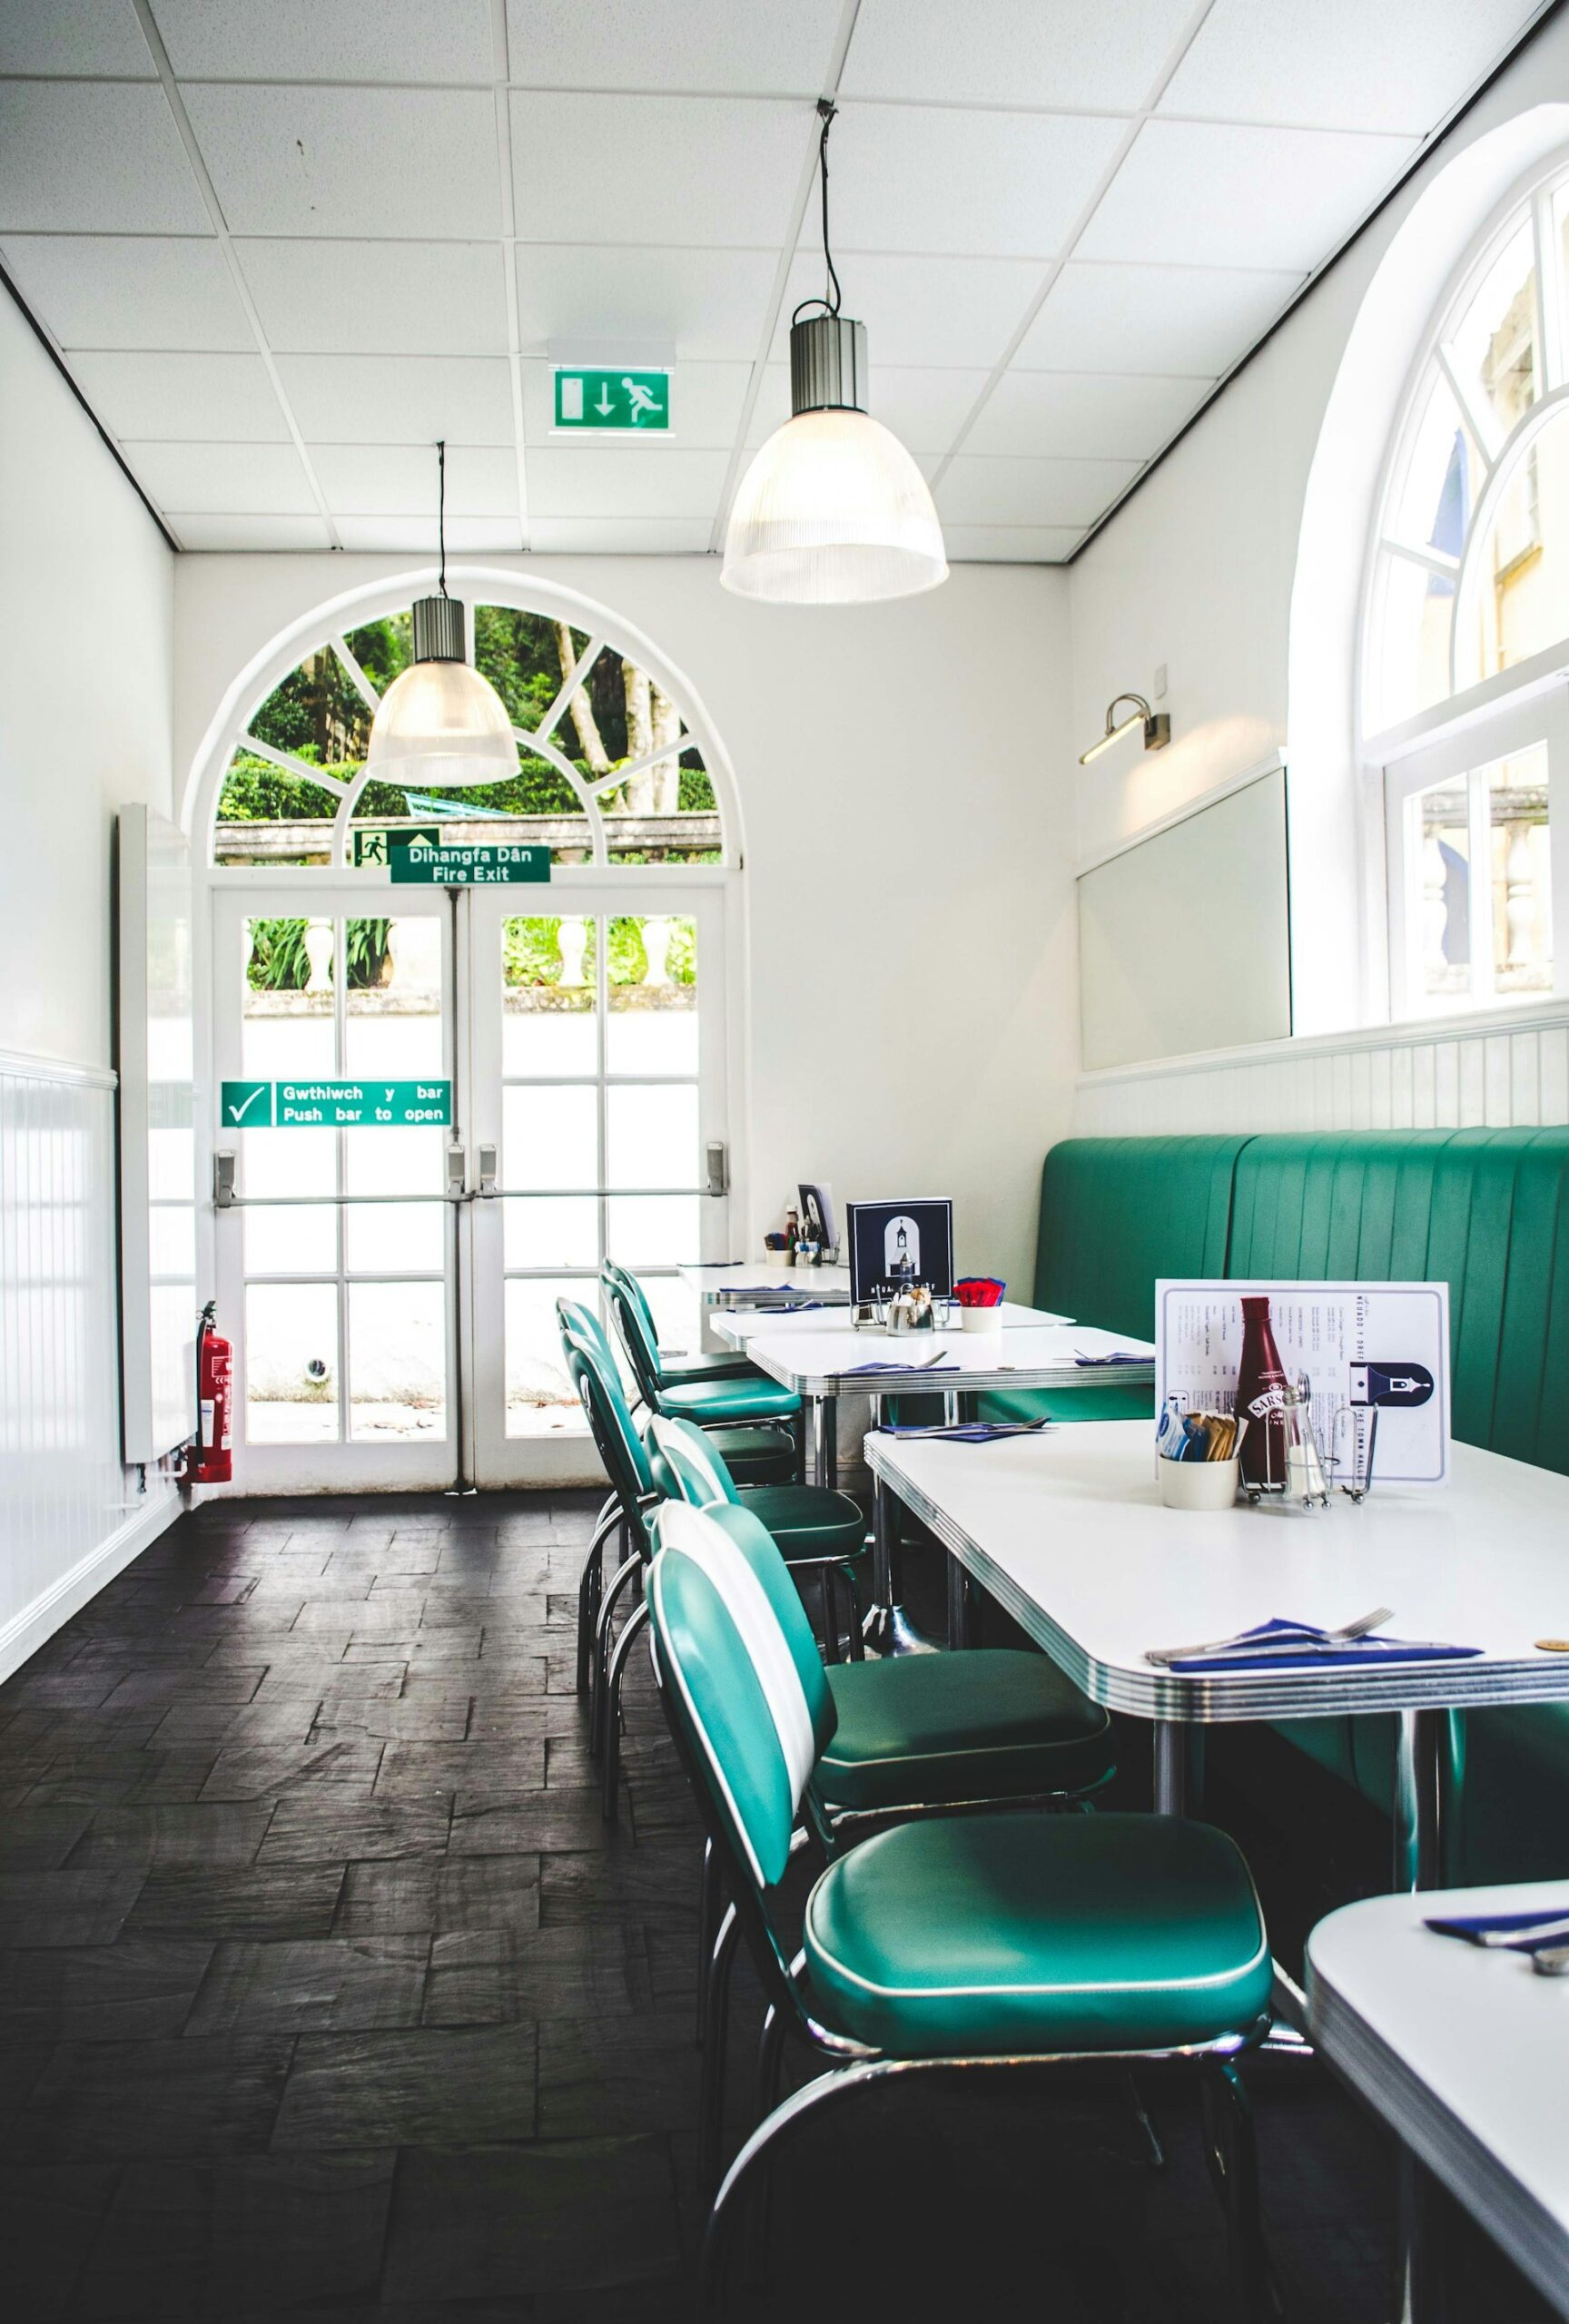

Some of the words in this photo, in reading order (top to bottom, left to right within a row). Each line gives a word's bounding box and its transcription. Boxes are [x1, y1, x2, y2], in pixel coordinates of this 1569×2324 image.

[410, 848, 490, 865] Dihangfa
[497, 847, 532, 862] Dân
[432, 866, 467, 881] Fire
[473, 866, 509, 881] Exit
[282, 1086, 363, 1100] Gwthiwch
[385, 1089, 395, 1102] y
[417, 1086, 443, 1099] bar
[283, 1108, 322, 1121] Push
[335, 1108, 362, 1121] bar
[375, 1108, 392, 1121] to
[405, 1108, 443, 1123] open
[1251, 1393, 1283, 1414] SARS
[1357, 1408, 1365, 1423] THE
